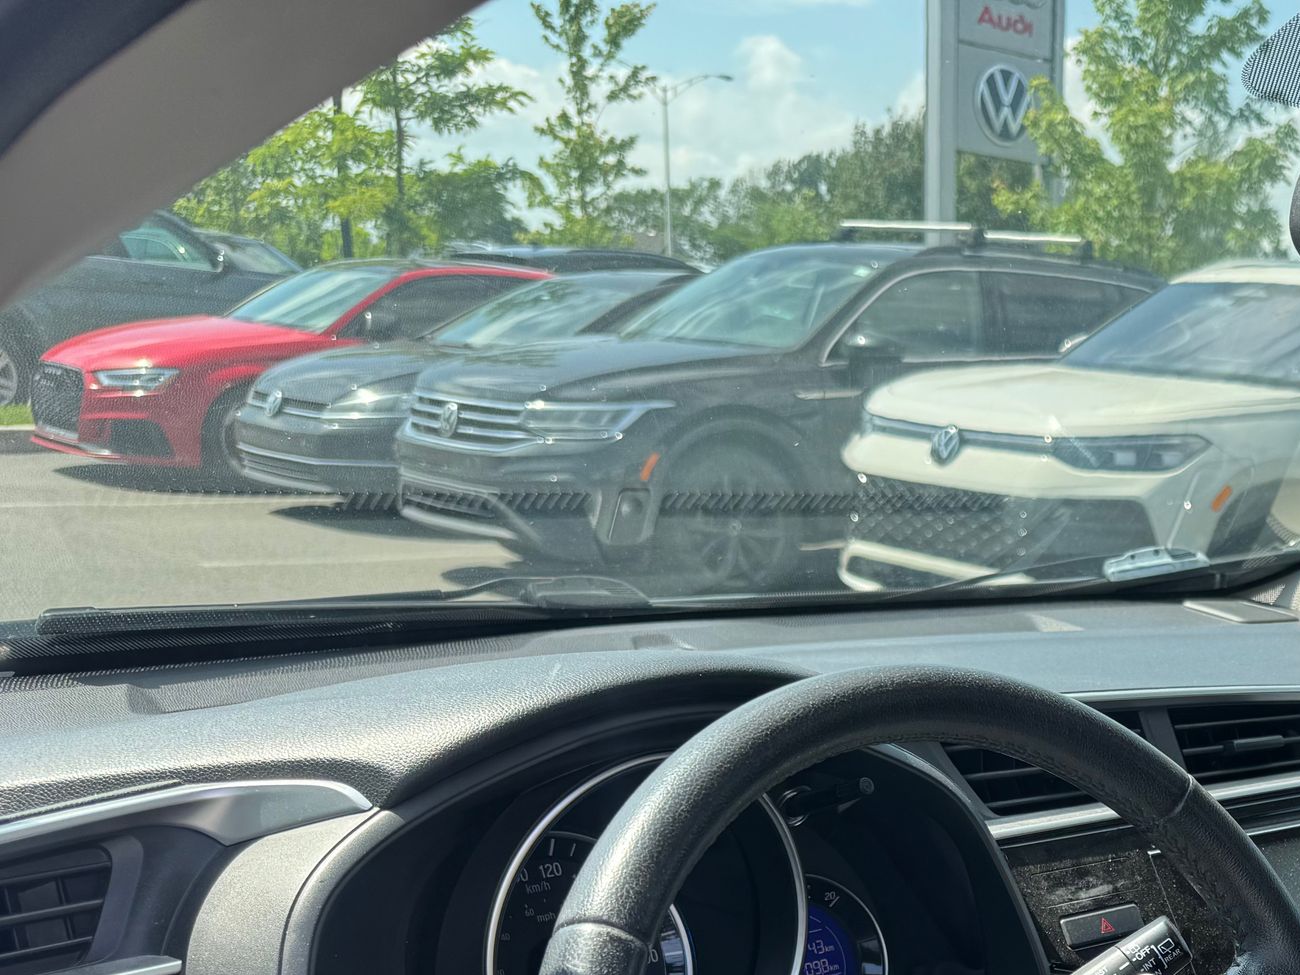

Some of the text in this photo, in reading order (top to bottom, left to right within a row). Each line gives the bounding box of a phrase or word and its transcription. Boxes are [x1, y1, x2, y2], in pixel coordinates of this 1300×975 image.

[978, 6, 1034, 37] Audi
[539, 862, 562, 879] 120
[525, 881, 551, 895] km/h
[824, 891, 836, 901] 20
[537, 911, 556, 924] mph
[1135, 946, 1152, 961] OFF
[1164, 948, 1182, 964] REAR
[1142, 957, 1157, 972] INT
